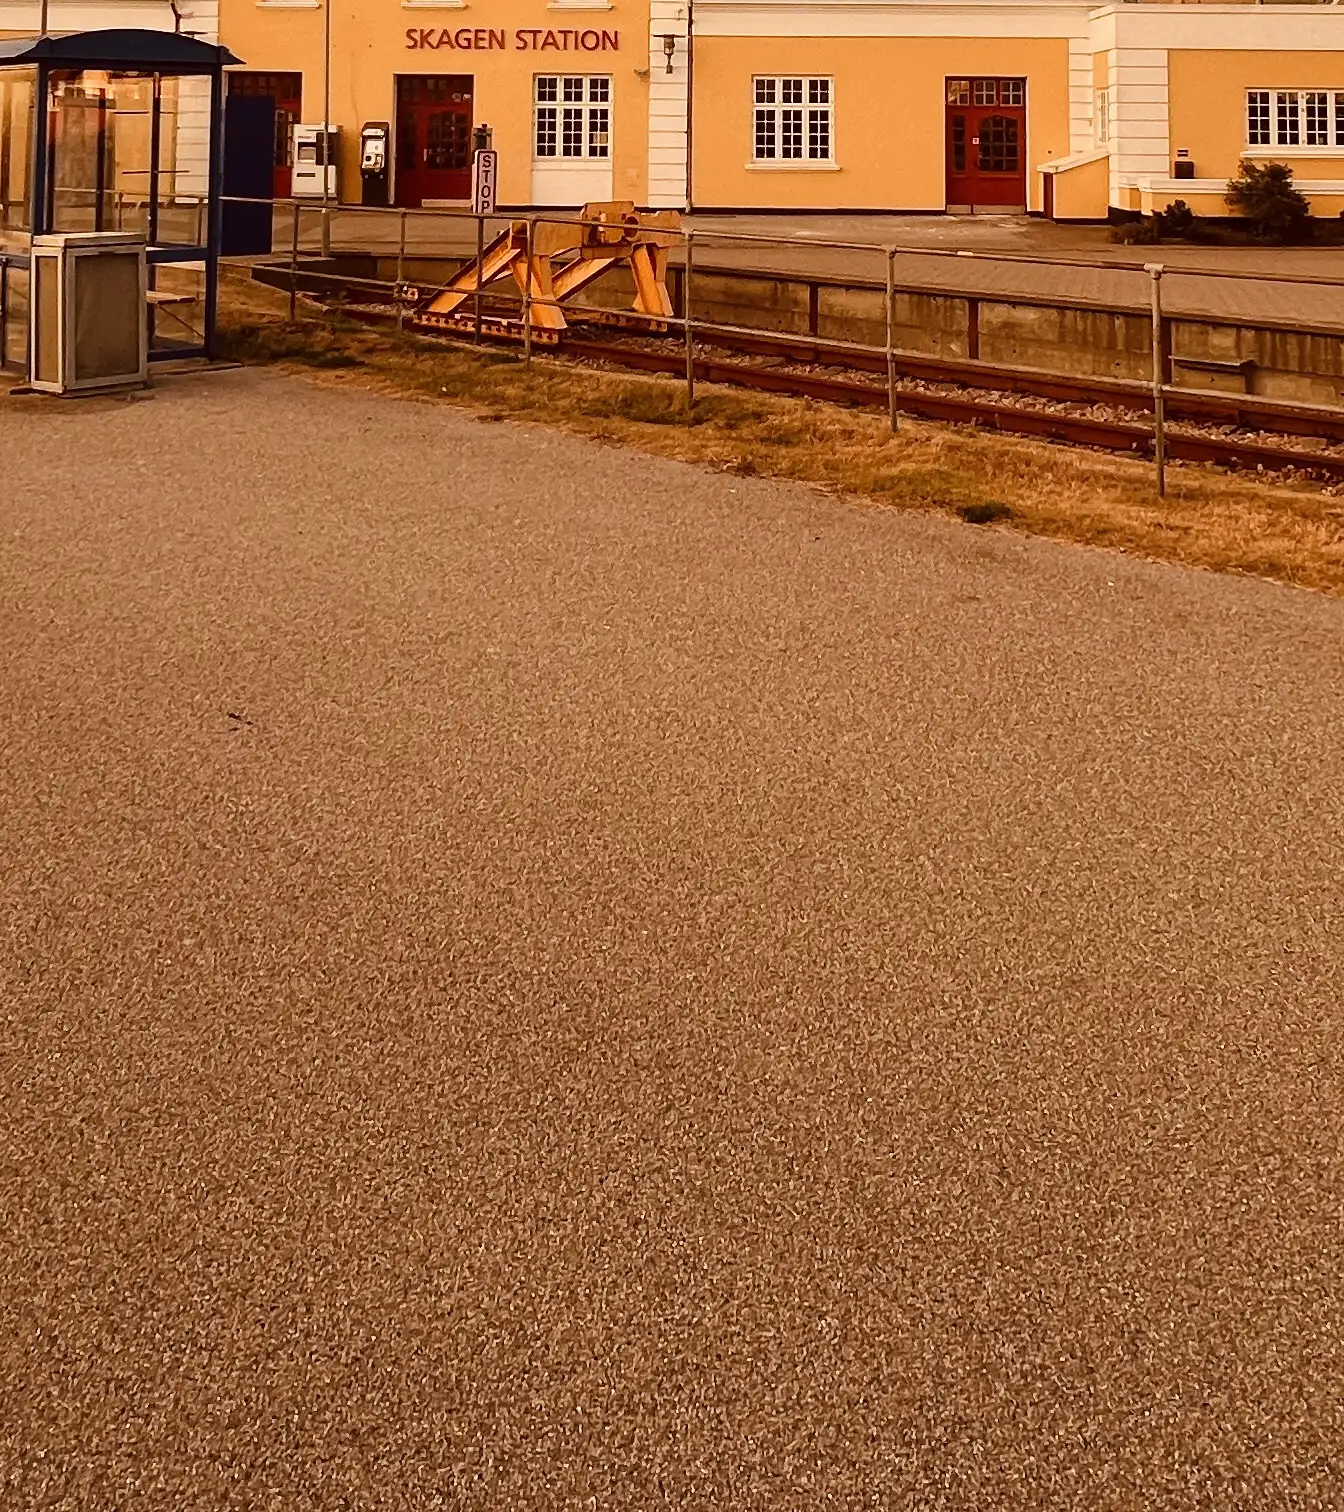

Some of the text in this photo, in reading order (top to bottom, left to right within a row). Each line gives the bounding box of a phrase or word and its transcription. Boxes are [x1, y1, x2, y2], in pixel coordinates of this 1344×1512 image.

[405, 28, 620, 52] SKAGEN STATION
[481, 154, 492, 214] STOP
